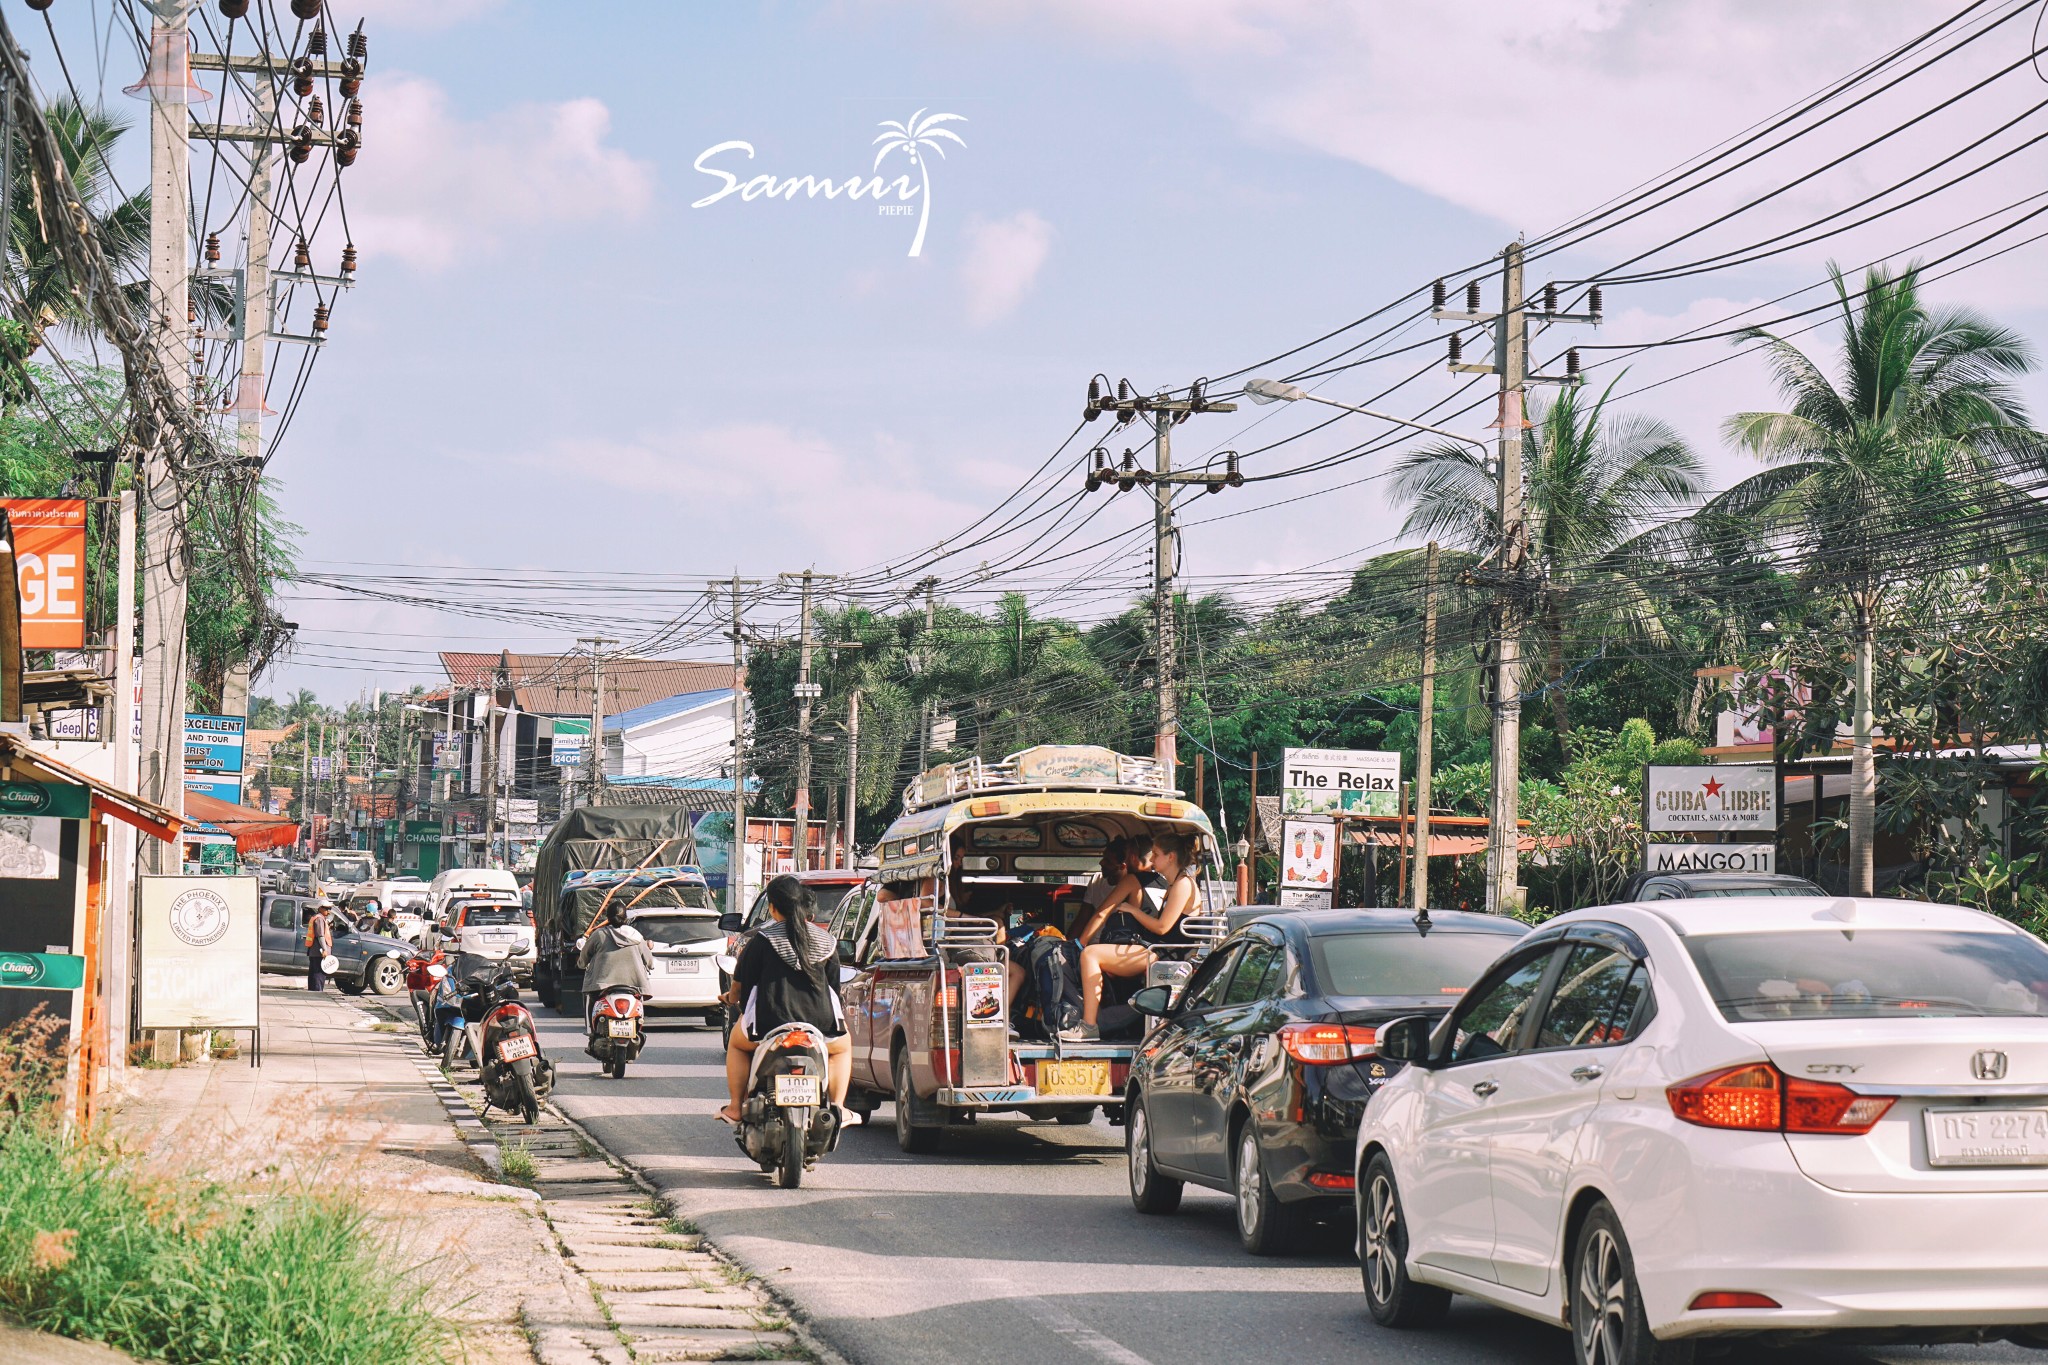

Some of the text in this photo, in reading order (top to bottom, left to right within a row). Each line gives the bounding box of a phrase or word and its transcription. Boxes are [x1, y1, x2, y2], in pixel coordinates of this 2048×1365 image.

[18, 553, 76, 614] GE
[56, 722, 81, 736] Jeep
[187, 734, 229, 743] AND TOUR
[1289, 770, 1395, 791] The Relax
[8, 792, 40, 804] Chang
[1655, 790, 1771, 812] CUBA LIBRE
[1668, 814, 1708, 822] COCKTAILS,
[1709, 814, 1730, 822] SALSA
[1740, 813, 1760, 822] MORE
[1657, 852, 1768, 871] MANGO 11
[173, 896, 187, 911] THE
[186, 891, 223, 906] PHOENIX
[172, 921, 226, 944] LIMITED PARTNERSHIP
[2, 961, 35, 975] Chang
[969, 967, 998, 975] TOYOTA
[1805, 1064, 1865, 1074] CITY
[783, 1095, 812, 1104] 6297
[1989, 1115, 2048, 1140] 2274
